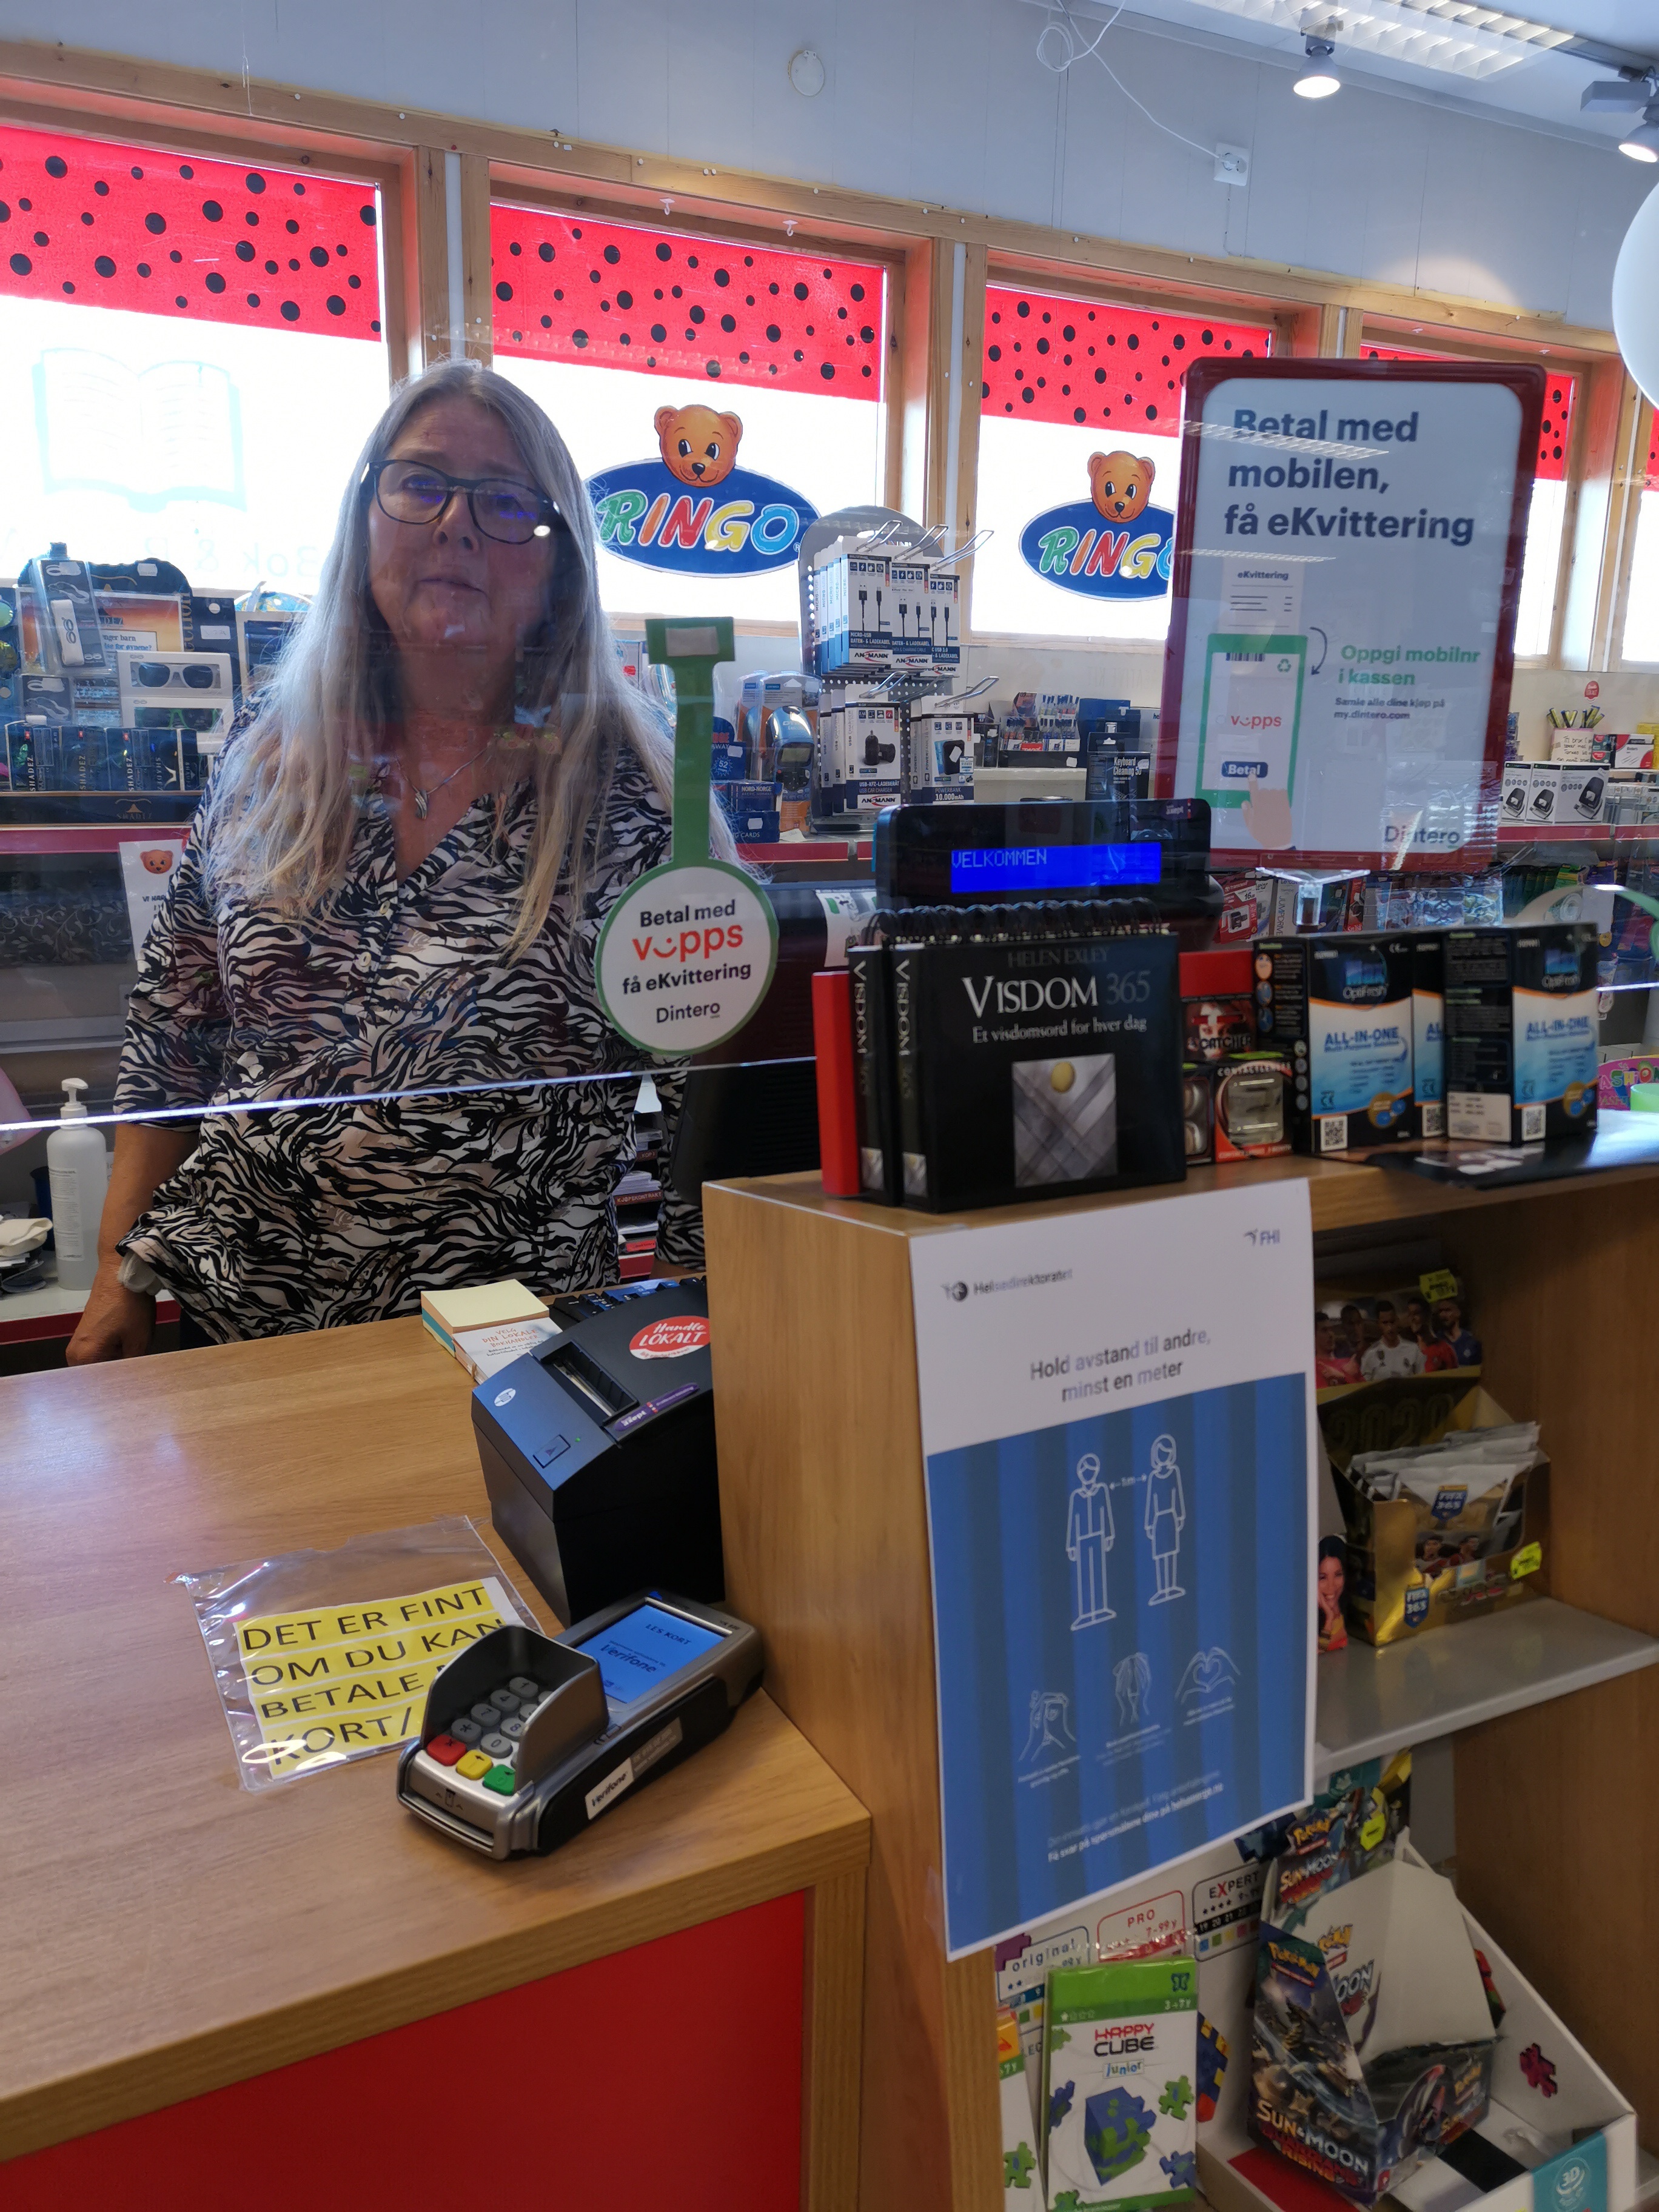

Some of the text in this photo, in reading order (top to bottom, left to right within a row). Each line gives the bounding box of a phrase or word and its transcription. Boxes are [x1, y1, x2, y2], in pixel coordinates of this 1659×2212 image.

[1233, 409, 1418, 443] Betal med
[1228, 458, 1389, 495] mobilen,
[599, 490, 799, 554] RINGO
[1225, 502, 1473, 546] få eKvittering
[1238, 570, 1289, 581] eKvittering
[1341, 645, 1480, 666] Oppgi mobilnr
[1339, 669, 1415, 686] i kassen
[1386, 699, 1407, 707] dine
[27, 757, 36, 792] SHADEZ
[126, 757, 134, 792] SHADEZ
[1113, 766, 1134, 776] Cleaning
[1114, 757, 1136, 766] Keyboard
[1228, 764, 1261, 776] Betal
[952, 849, 1047, 868] VELKOMMEN
[640, 900, 736, 927] Betal med
[1276, 896, 1287, 936] JUMPDRIVE
[623, 963, 752, 995] få eKvittering
[854, 960, 868, 1054] VISDOM
[896, 959, 910, 1056] VISDOM
[962, 971, 1150, 1018] VISDOM 365
[656, 1001, 721, 1024] Dintero
[973, 1014, 1147, 1044] Et visdomsord for hver dag
[1325, 1027, 1399, 1046] ALL-IN-ONE
[490, 1335, 540, 1347] BOKHANDLER
[503, 1329, 539, 1339] LOKALE
[638, 1332, 707, 1346] LOKALT
[653, 1322, 706, 1334] Handle
[1031, 1327, 1212, 1380] Hold avstand til andre,
[1061, 1359, 1184, 1403] minst en meter
[243, 1586, 487, 1651] DET ER FINT
[645, 1623, 692, 1646] LES KORT
[250, 1660, 331, 1687] OM
[346, 1640, 407, 1669] DU
[261, 1672, 425, 1720] BETALE
[1209, 1871, 1259, 1899] EXPERT
[1127, 1909, 1156, 1928] PRO
[1012, 1937, 1075, 1972] original
[1094, 2023, 1155, 2042] HAPPY
[1093, 2036, 1155, 2057] CUBE
